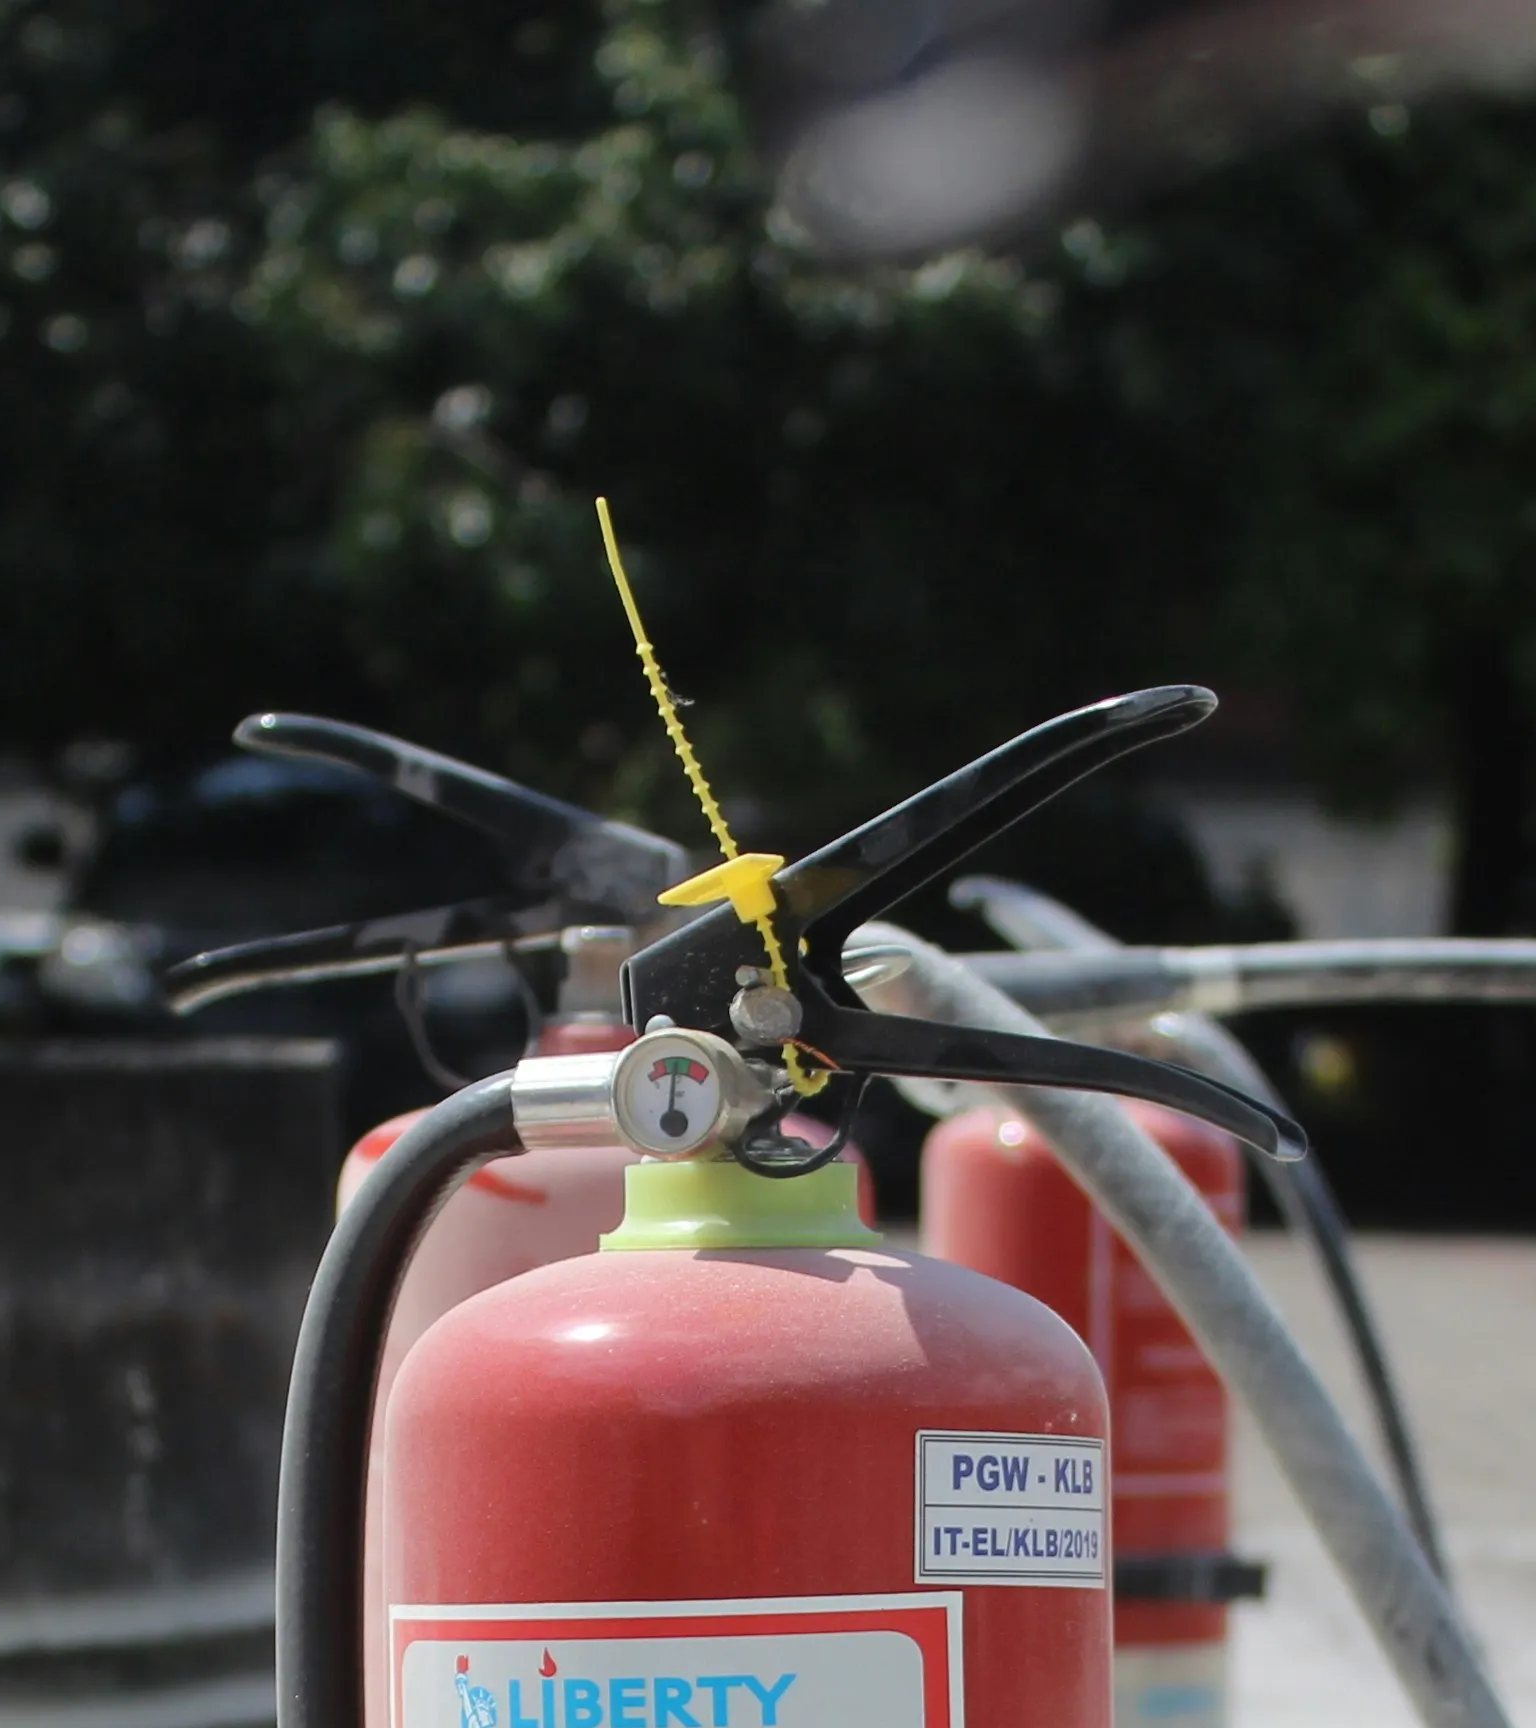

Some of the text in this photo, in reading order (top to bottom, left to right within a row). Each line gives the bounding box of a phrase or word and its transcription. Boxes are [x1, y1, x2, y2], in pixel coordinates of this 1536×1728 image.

[952, 1454, 1030, 1493] PGW
[1054, 1457, 1093, 1495] KLB
[932, 1525, 1099, 1560] IT-EL/KLB/2019
